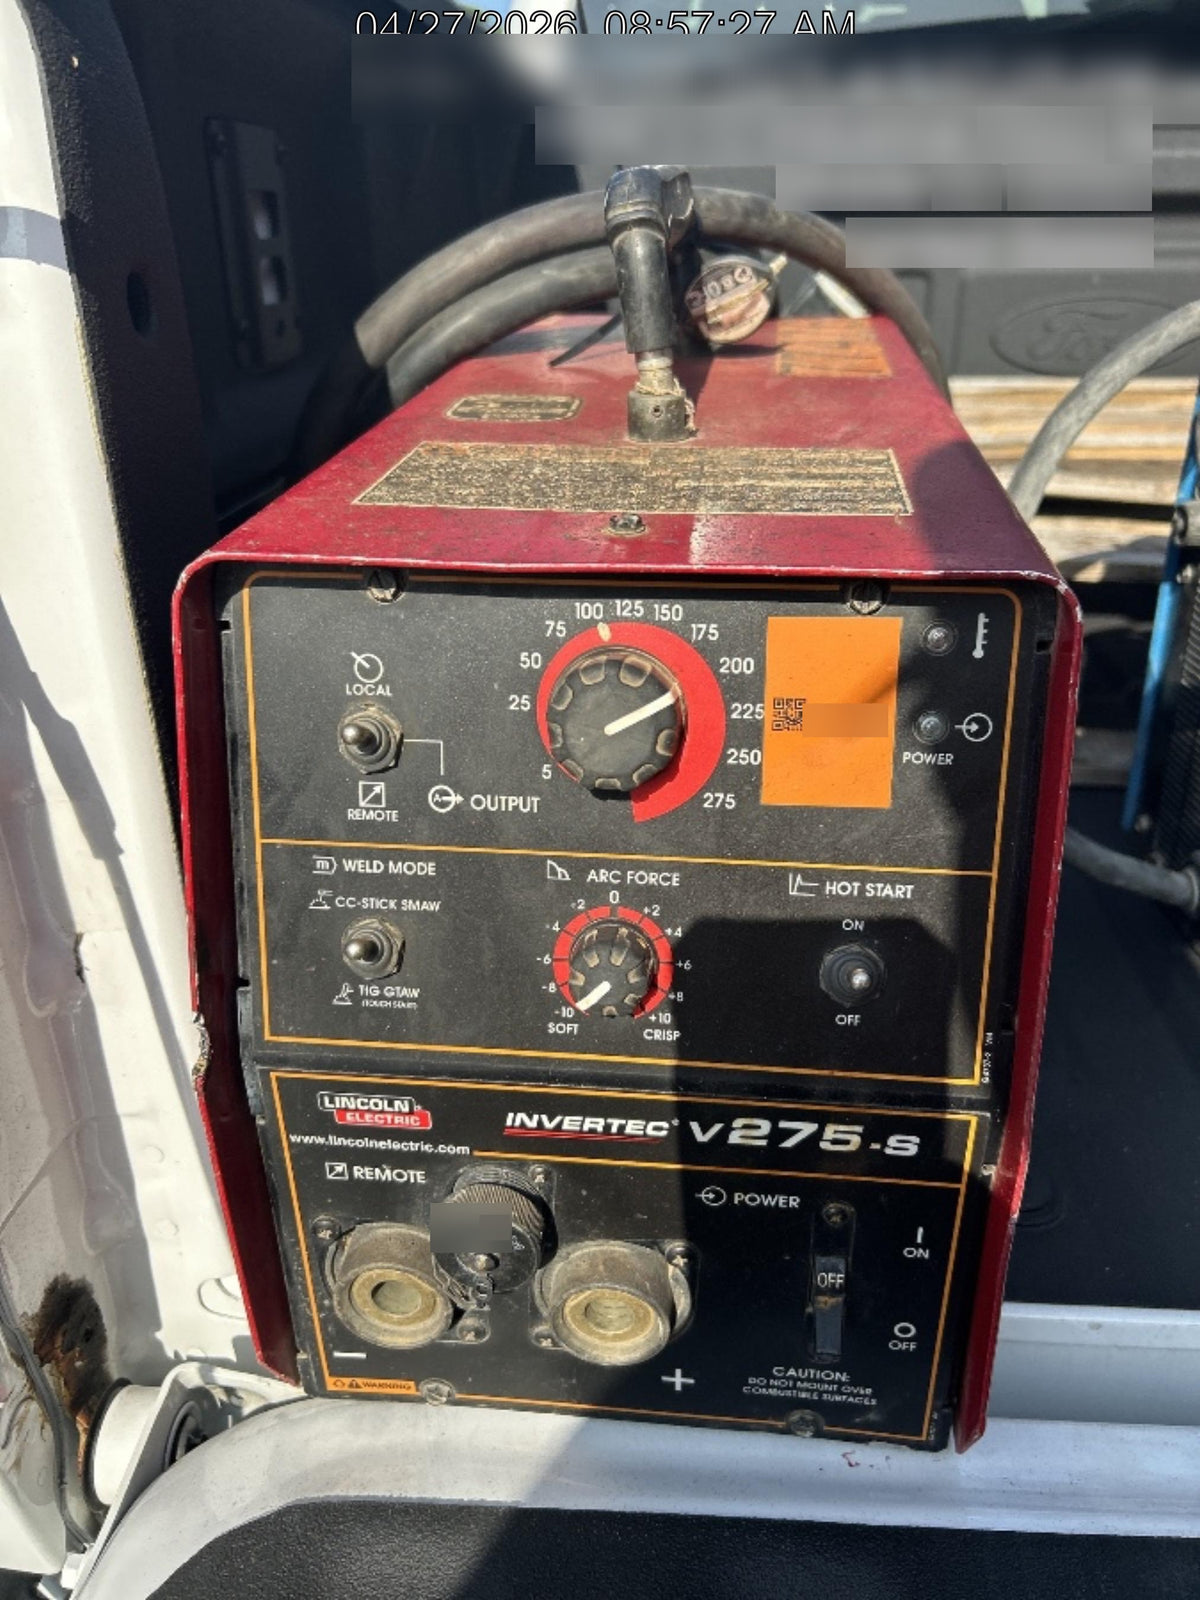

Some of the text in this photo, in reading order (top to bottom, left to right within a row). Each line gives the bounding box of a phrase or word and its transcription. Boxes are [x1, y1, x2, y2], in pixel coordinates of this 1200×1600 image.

[575, 602, 603, 620] 100
[614, 600, 645, 617] 125
[654, 604, 683, 622] 150
[545, 621, 566, 637] 75
[691, 623, 719, 641] 175
[519, 652, 542, 669] 50
[719, 657, 755, 674] 200
[345, 683, 393, 697] LOCAL
[508, 695, 531, 711] 25
[730, 703, 765, 720] 225
[726, 748, 762, 765] 250
[902, 751, 954, 766] POWER
[541, 764, 552, 779] 5
[470, 794, 541, 813] OUTPUT
[703, 793, 736, 810] 275
[347, 808, 399, 822] REMOTE
[342, 858, 437, 876] WELD MODE
[586, 869, 680, 886] ARC FORCE
[609, 890, 620, 904] 0
[825, 881, 915, 899] HOT START
[335, 896, 442, 913] CC-STICK SMAW
[643, 904, 660, 916] +2
[665, 926, 682, 938] +4
[841, 918, 865, 932] ON
[536, 953, 552, 965] -6
[676, 959, 693, 971] +6
[358, 984, 420, 998] TIG GTAW
[541, 982, 557, 993] -8
[668, 991, 684, 1002] +8
[554, 1006, 575, 1018] -10
[648, 1012, 672, 1025] +10
[835, 1014, 862, 1027] OFF
[547, 1023, 580, 1035] SOFT
[643, 1028, 681, 1041] CRISP
[322, 1095, 410, 1113] LINCOLN
[346, 1112, 421, 1127] ELECTRIC
[505, 1111, 669, 1138] INVERTEC
[289, 1133, 471, 1156] www.lincolnelectric.com
[353, 1165, 427, 1184] REMOTE
[733, 1192, 801, 1209] POWER
[903, 1246, 930, 1260] ON
[817, 1271, 846, 1289] OFF
[888, 1339, 918, 1352] OFF
[772, 1366, 851, 1382] CAUTION:
[748, 1377, 767, 1386] DO
[769, 1378, 794, 1388] NOT
